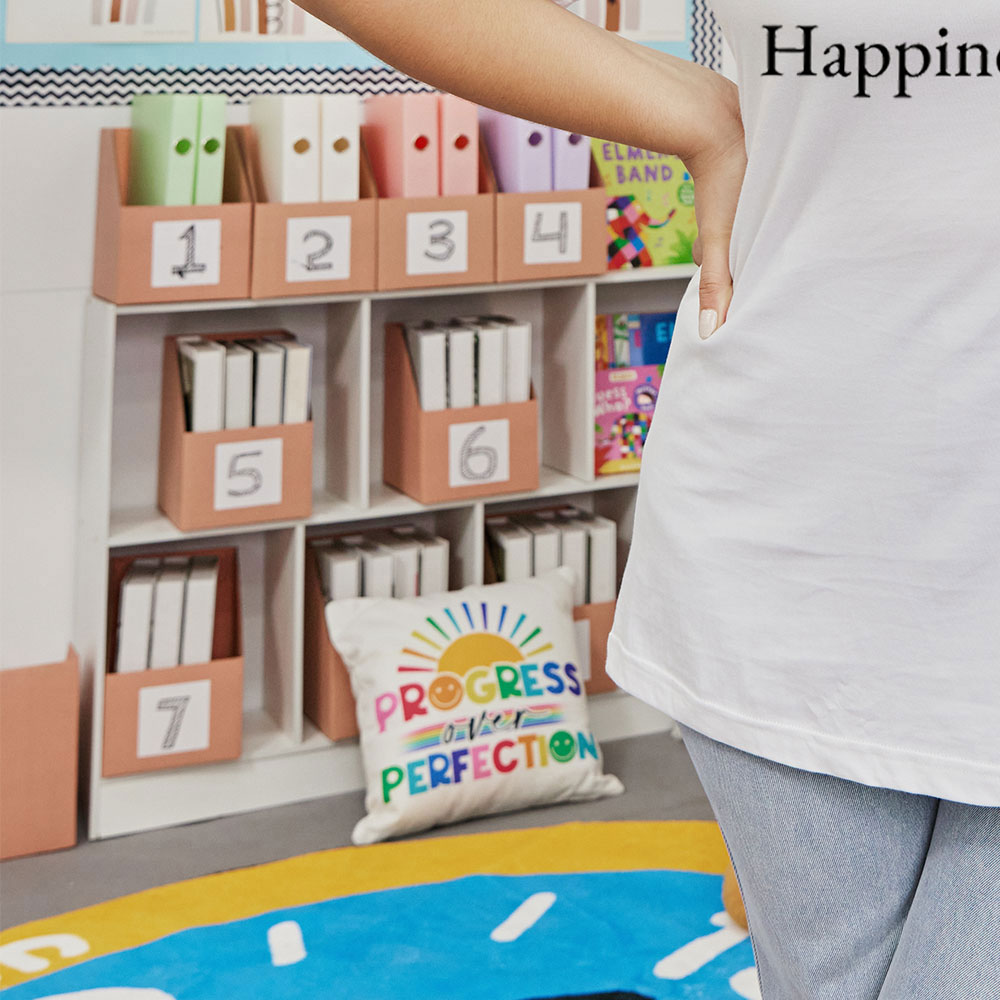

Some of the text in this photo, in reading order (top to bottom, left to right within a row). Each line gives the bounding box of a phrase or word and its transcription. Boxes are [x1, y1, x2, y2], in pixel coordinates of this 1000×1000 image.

[616, 164, 673, 184] BAND
[171, 224, 206, 279] 1
[303, 229, 334, 272] 2
[423, 219, 456, 263] 3
[531, 210, 568, 255] 4
[227, 450, 263, 498] 5
[459, 425, 498, 482] 6
[375, 661, 582, 734] PROGRESS
[156, 694, 191, 750] 7
[442, 709, 533, 744] over
[380, 730, 599, 804] PERFECTION
